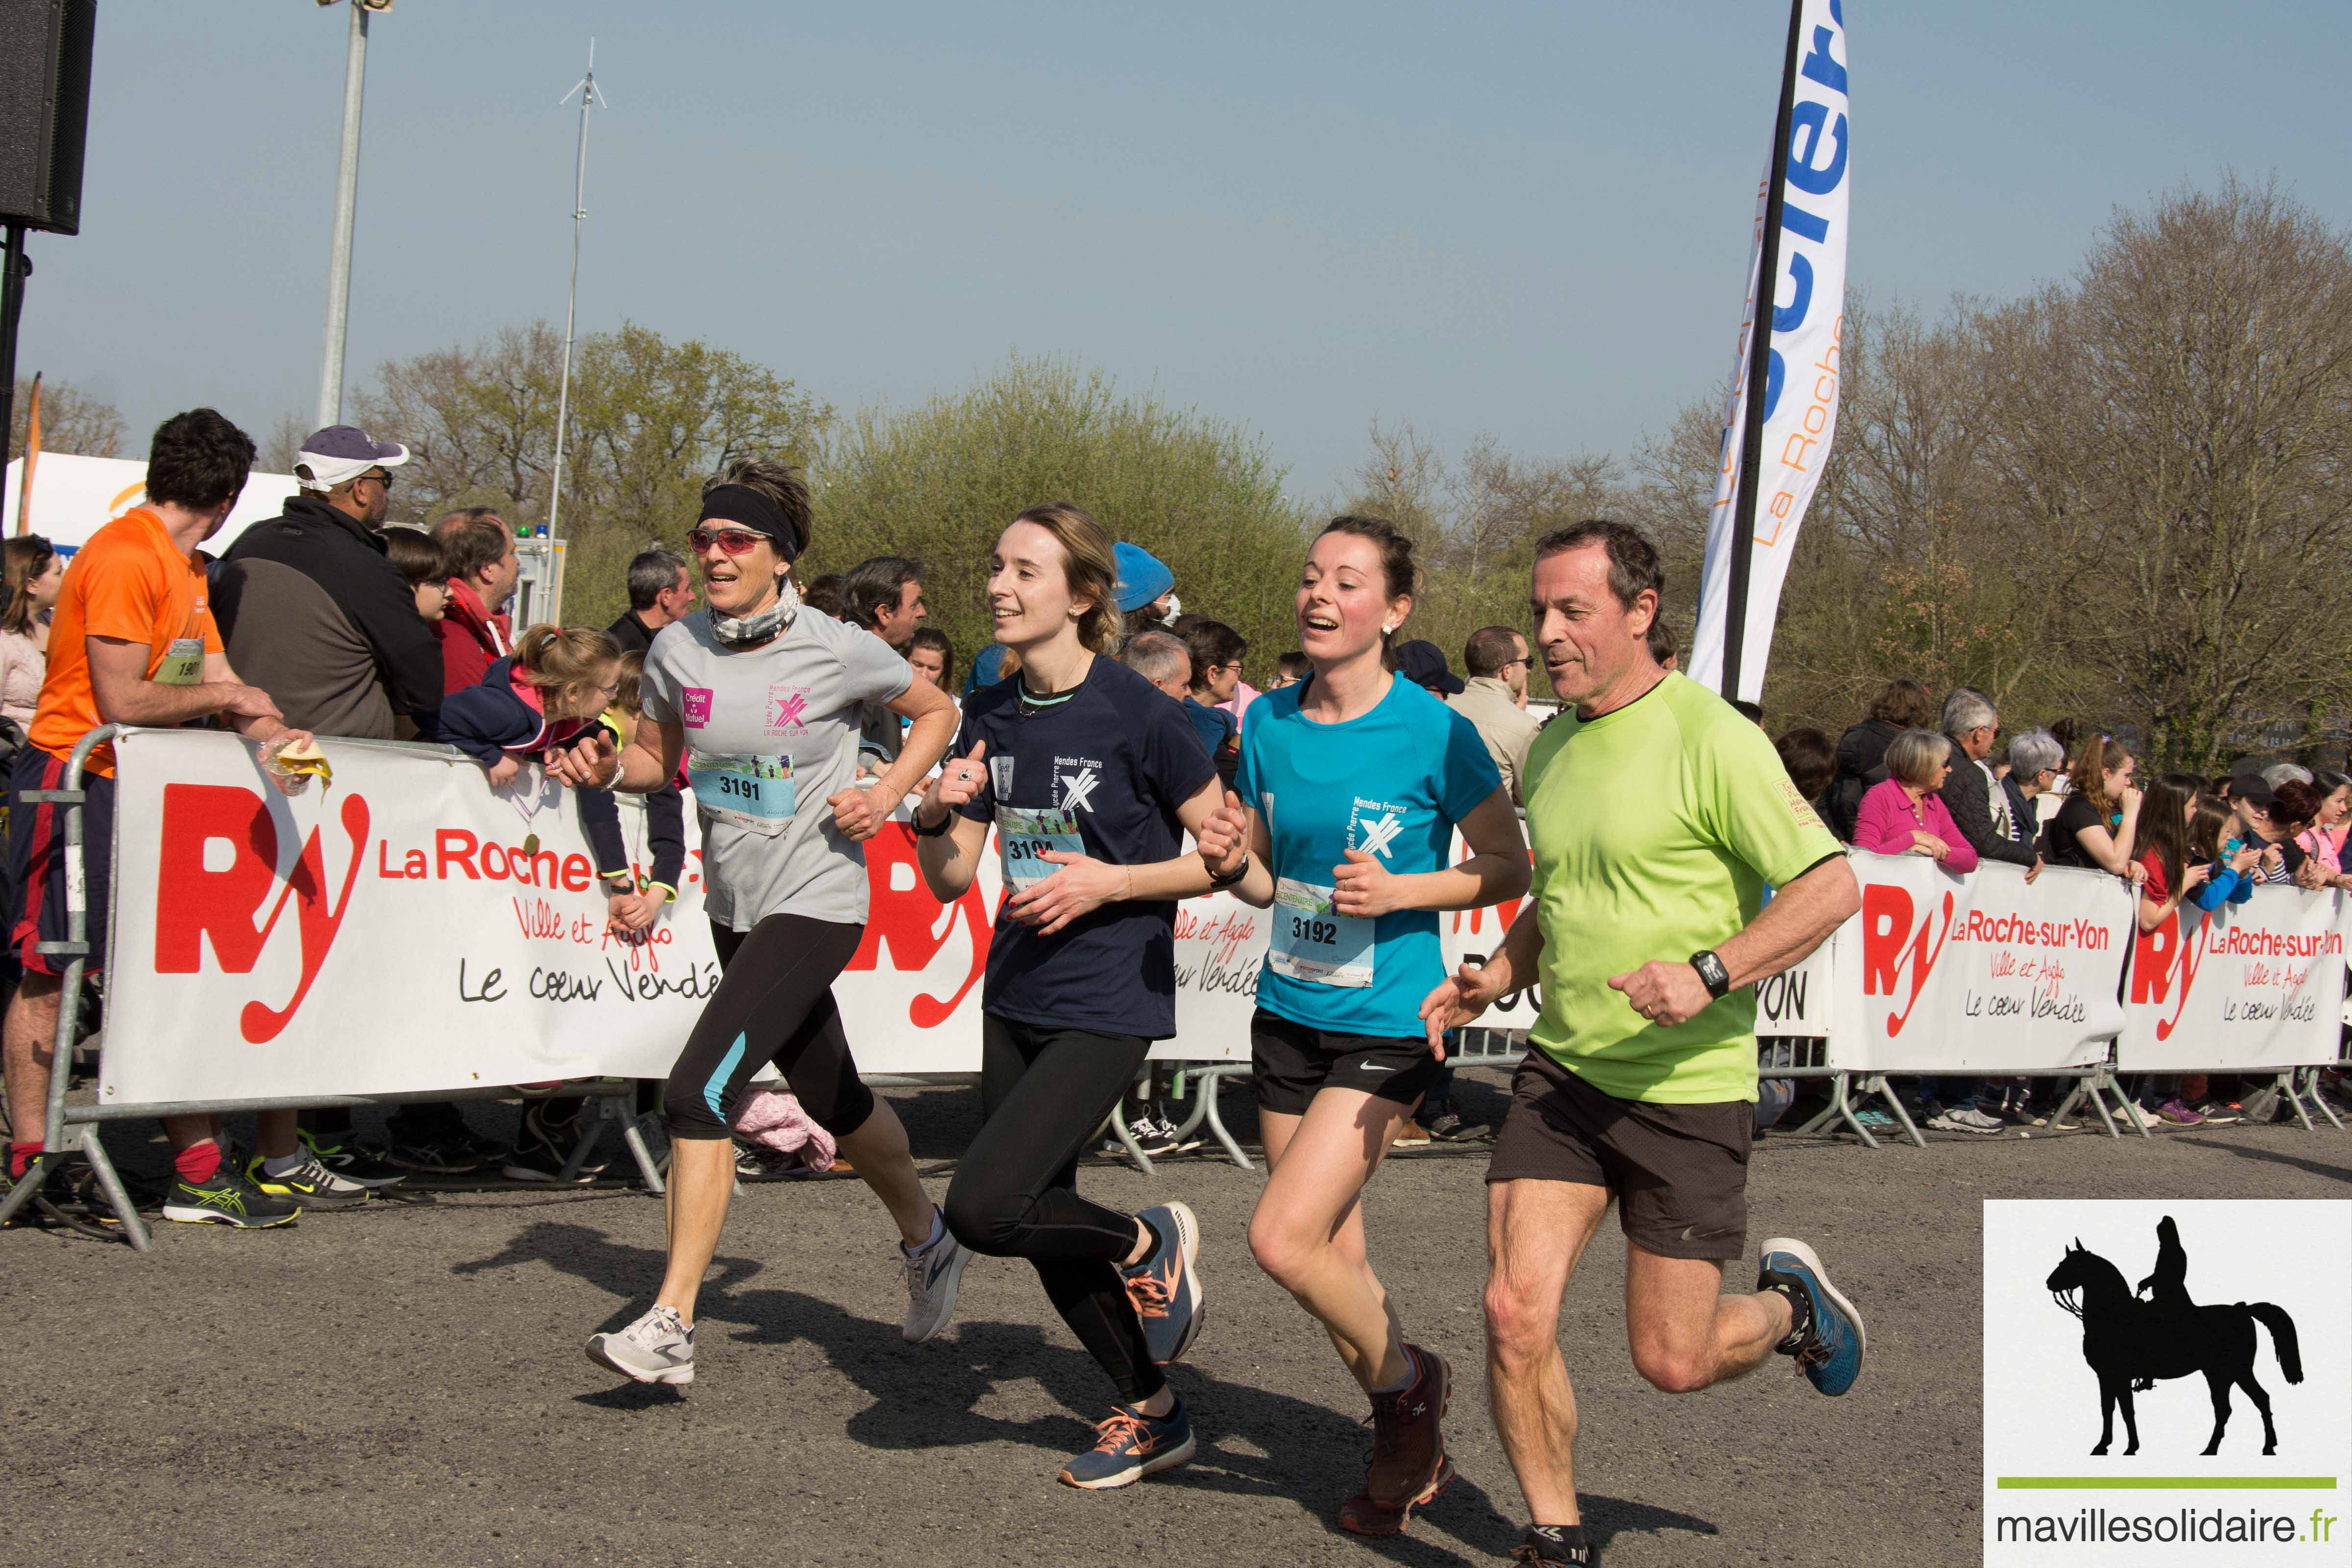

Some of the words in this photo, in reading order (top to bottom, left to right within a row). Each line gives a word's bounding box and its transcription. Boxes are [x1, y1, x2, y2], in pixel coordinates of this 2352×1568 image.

[1753, 492, 1794, 547] La
[686, 692, 706, 703] Crédit
[792, 685, 811, 693] France
[686, 713, 704, 723] Mutuel
[1054, 756, 1078, 766] Mendes
[1079, 757, 1102, 769] France
[719, 776, 760, 801] 3191
[1051, 765, 1060, 788] Pierre
[1353, 796, 1381, 811] Mendes
[1382, 801, 1407, 814] France
[1347, 807, 1360, 832] Pierre
[1347, 833, 1356, 851] ycée
[379, 839, 427, 879] La
[513, 896, 564, 940] Ville
[572, 912, 593, 945] et
[1199, 914, 1219, 941] et
[1292, 916, 1337, 945] 3192
[1952, 918, 1965, 941] La
[2209, 932, 2226, 954] La
[461, 957, 508, 1003] Le
[1990, 950, 2016, 979] Ville
[2019, 955, 2037, 978] et
[2035, 954, 2065, 999] Agglo
[2244, 960, 2269, 988] Ville
[1965, 988, 1982, 1017] Le
[2031, 986, 2085, 1023] Vendée
[2224, 996, 2236, 1021] Le
